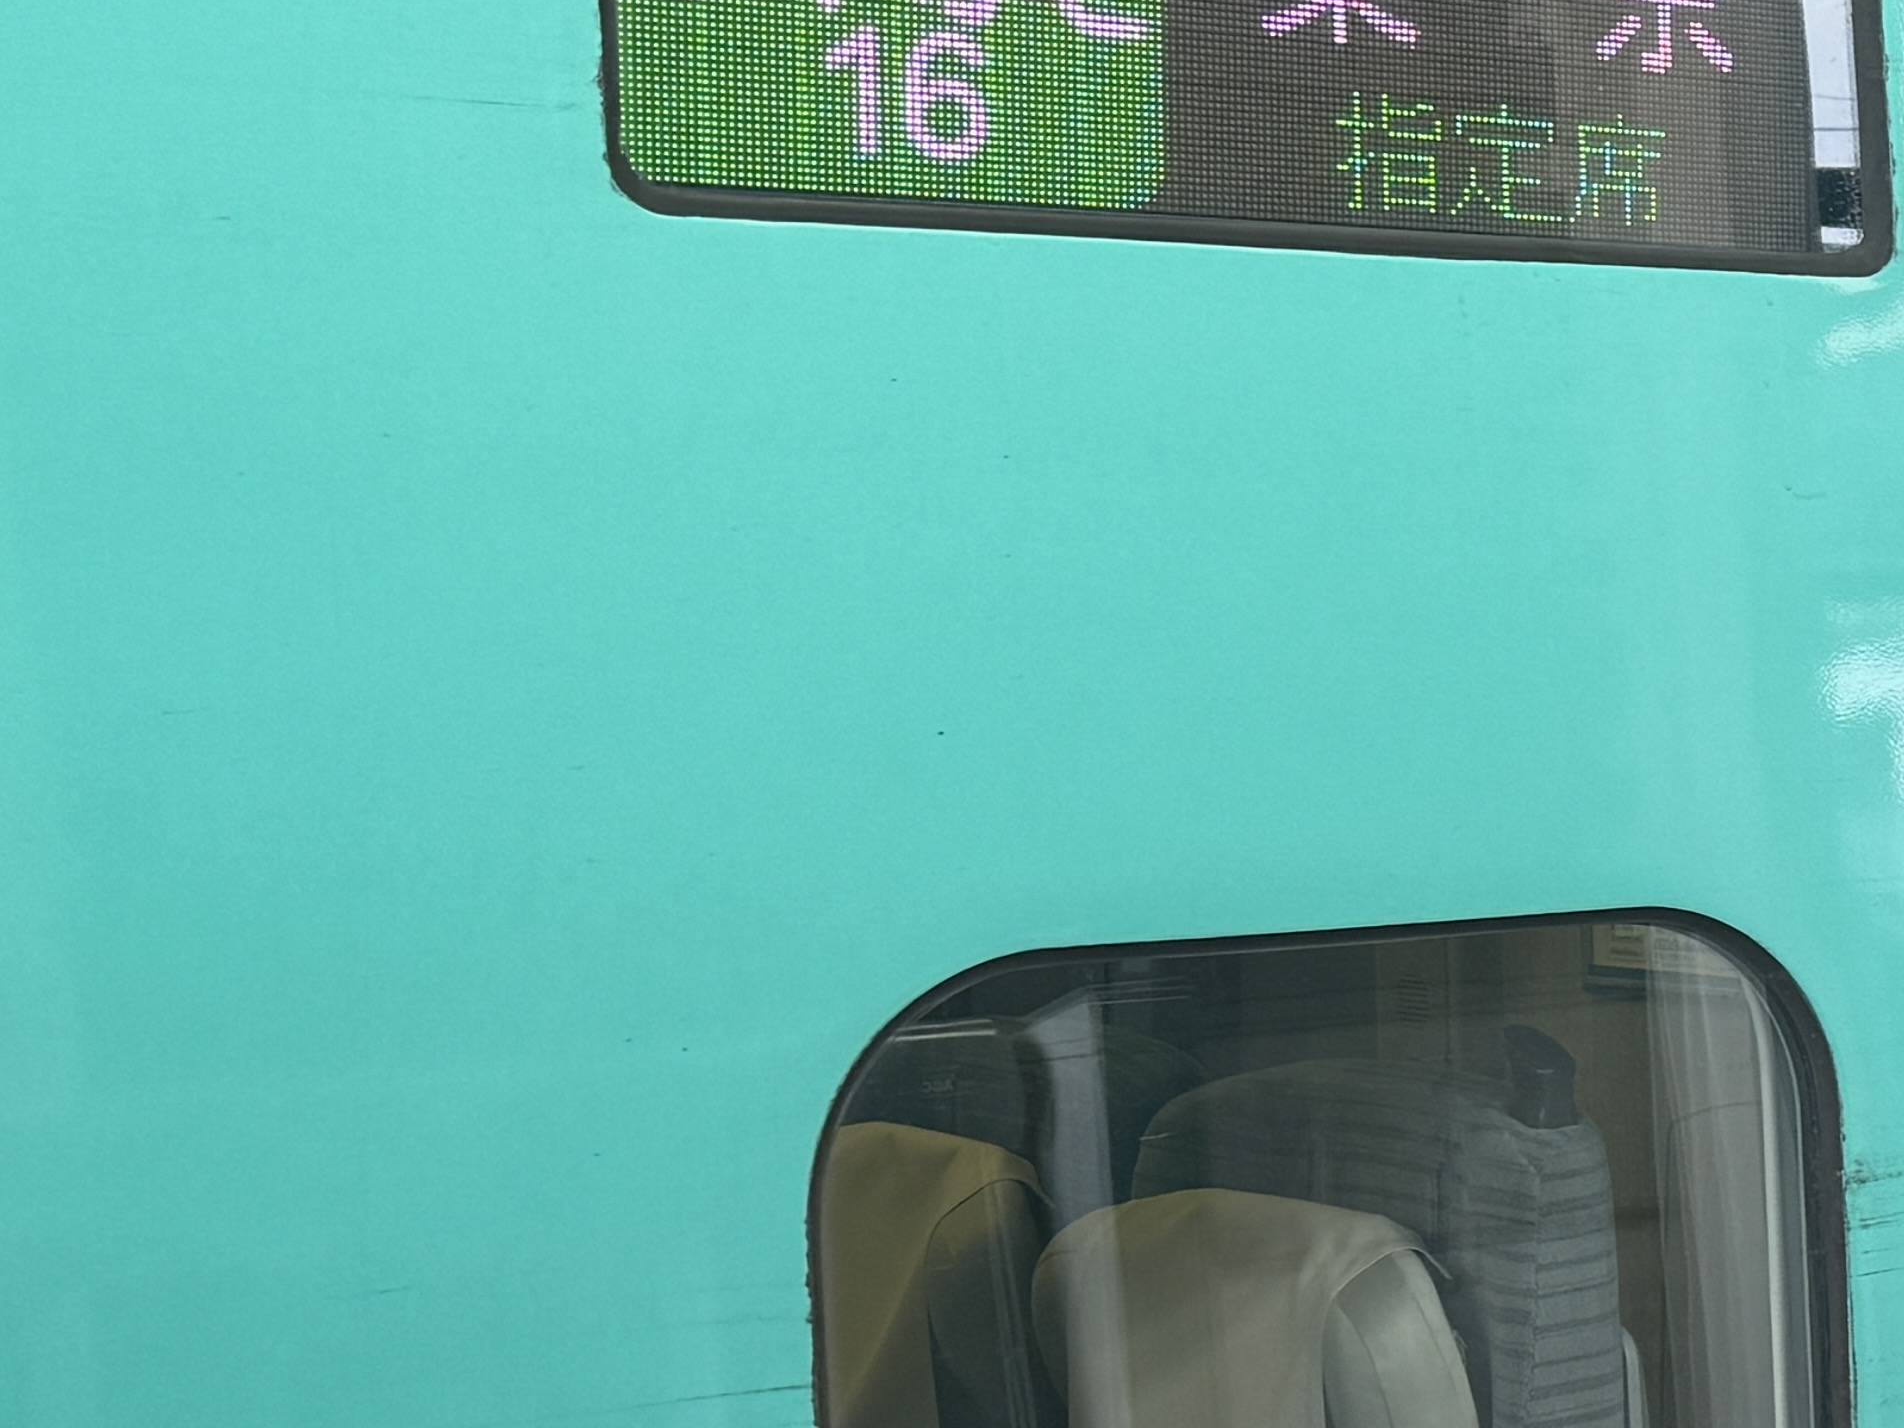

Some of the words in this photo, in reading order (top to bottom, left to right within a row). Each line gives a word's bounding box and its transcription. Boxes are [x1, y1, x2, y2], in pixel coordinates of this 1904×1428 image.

[825, 25, 988, 162] 16
[1335, 91, 1667, 227] 指定席
